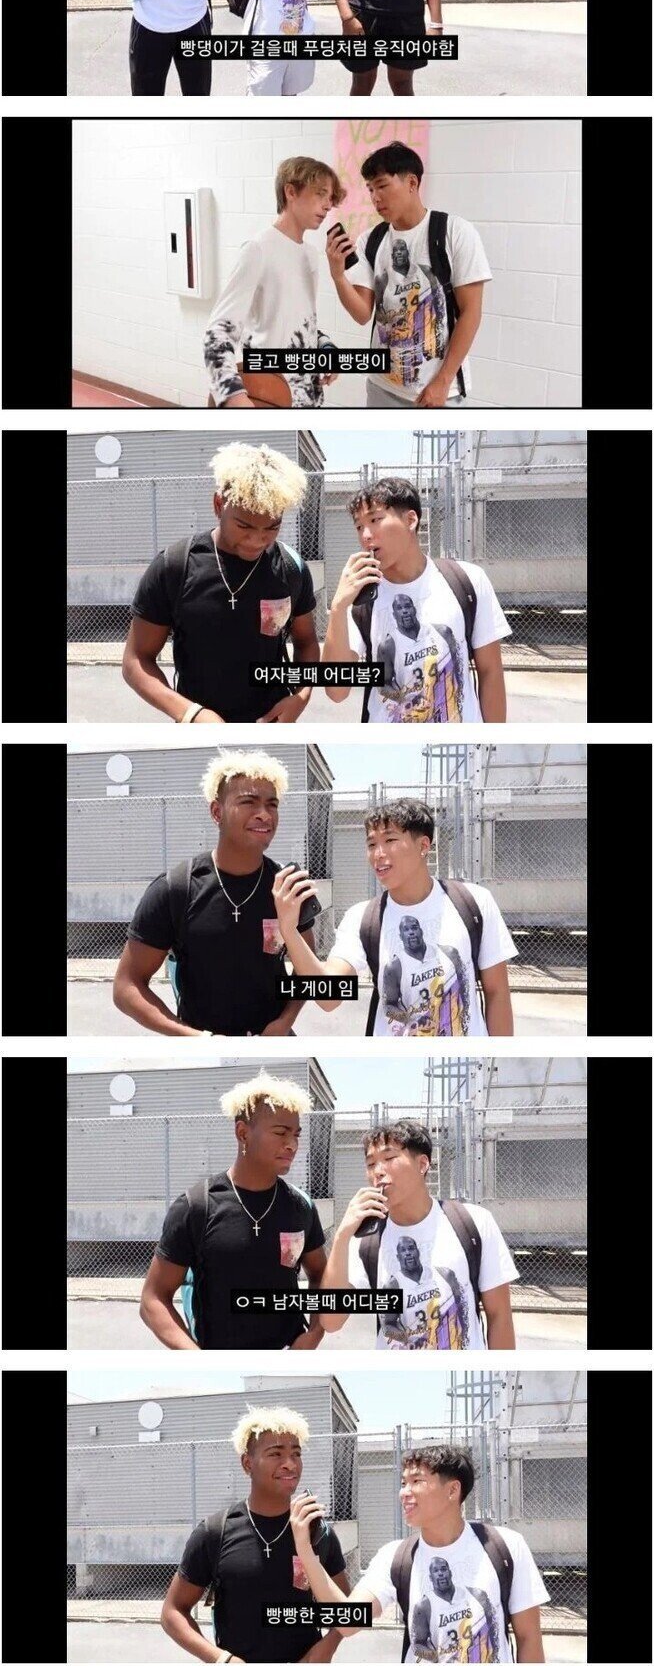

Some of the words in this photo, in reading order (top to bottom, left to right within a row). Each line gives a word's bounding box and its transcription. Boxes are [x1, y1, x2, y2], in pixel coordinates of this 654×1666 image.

[404, 645, 439, 667] LAKERS
[411, 966, 445, 987] LAKERS
[407, 1288, 441, 1309] LAKERS
[438, 1608, 473, 1628] LAKERS
